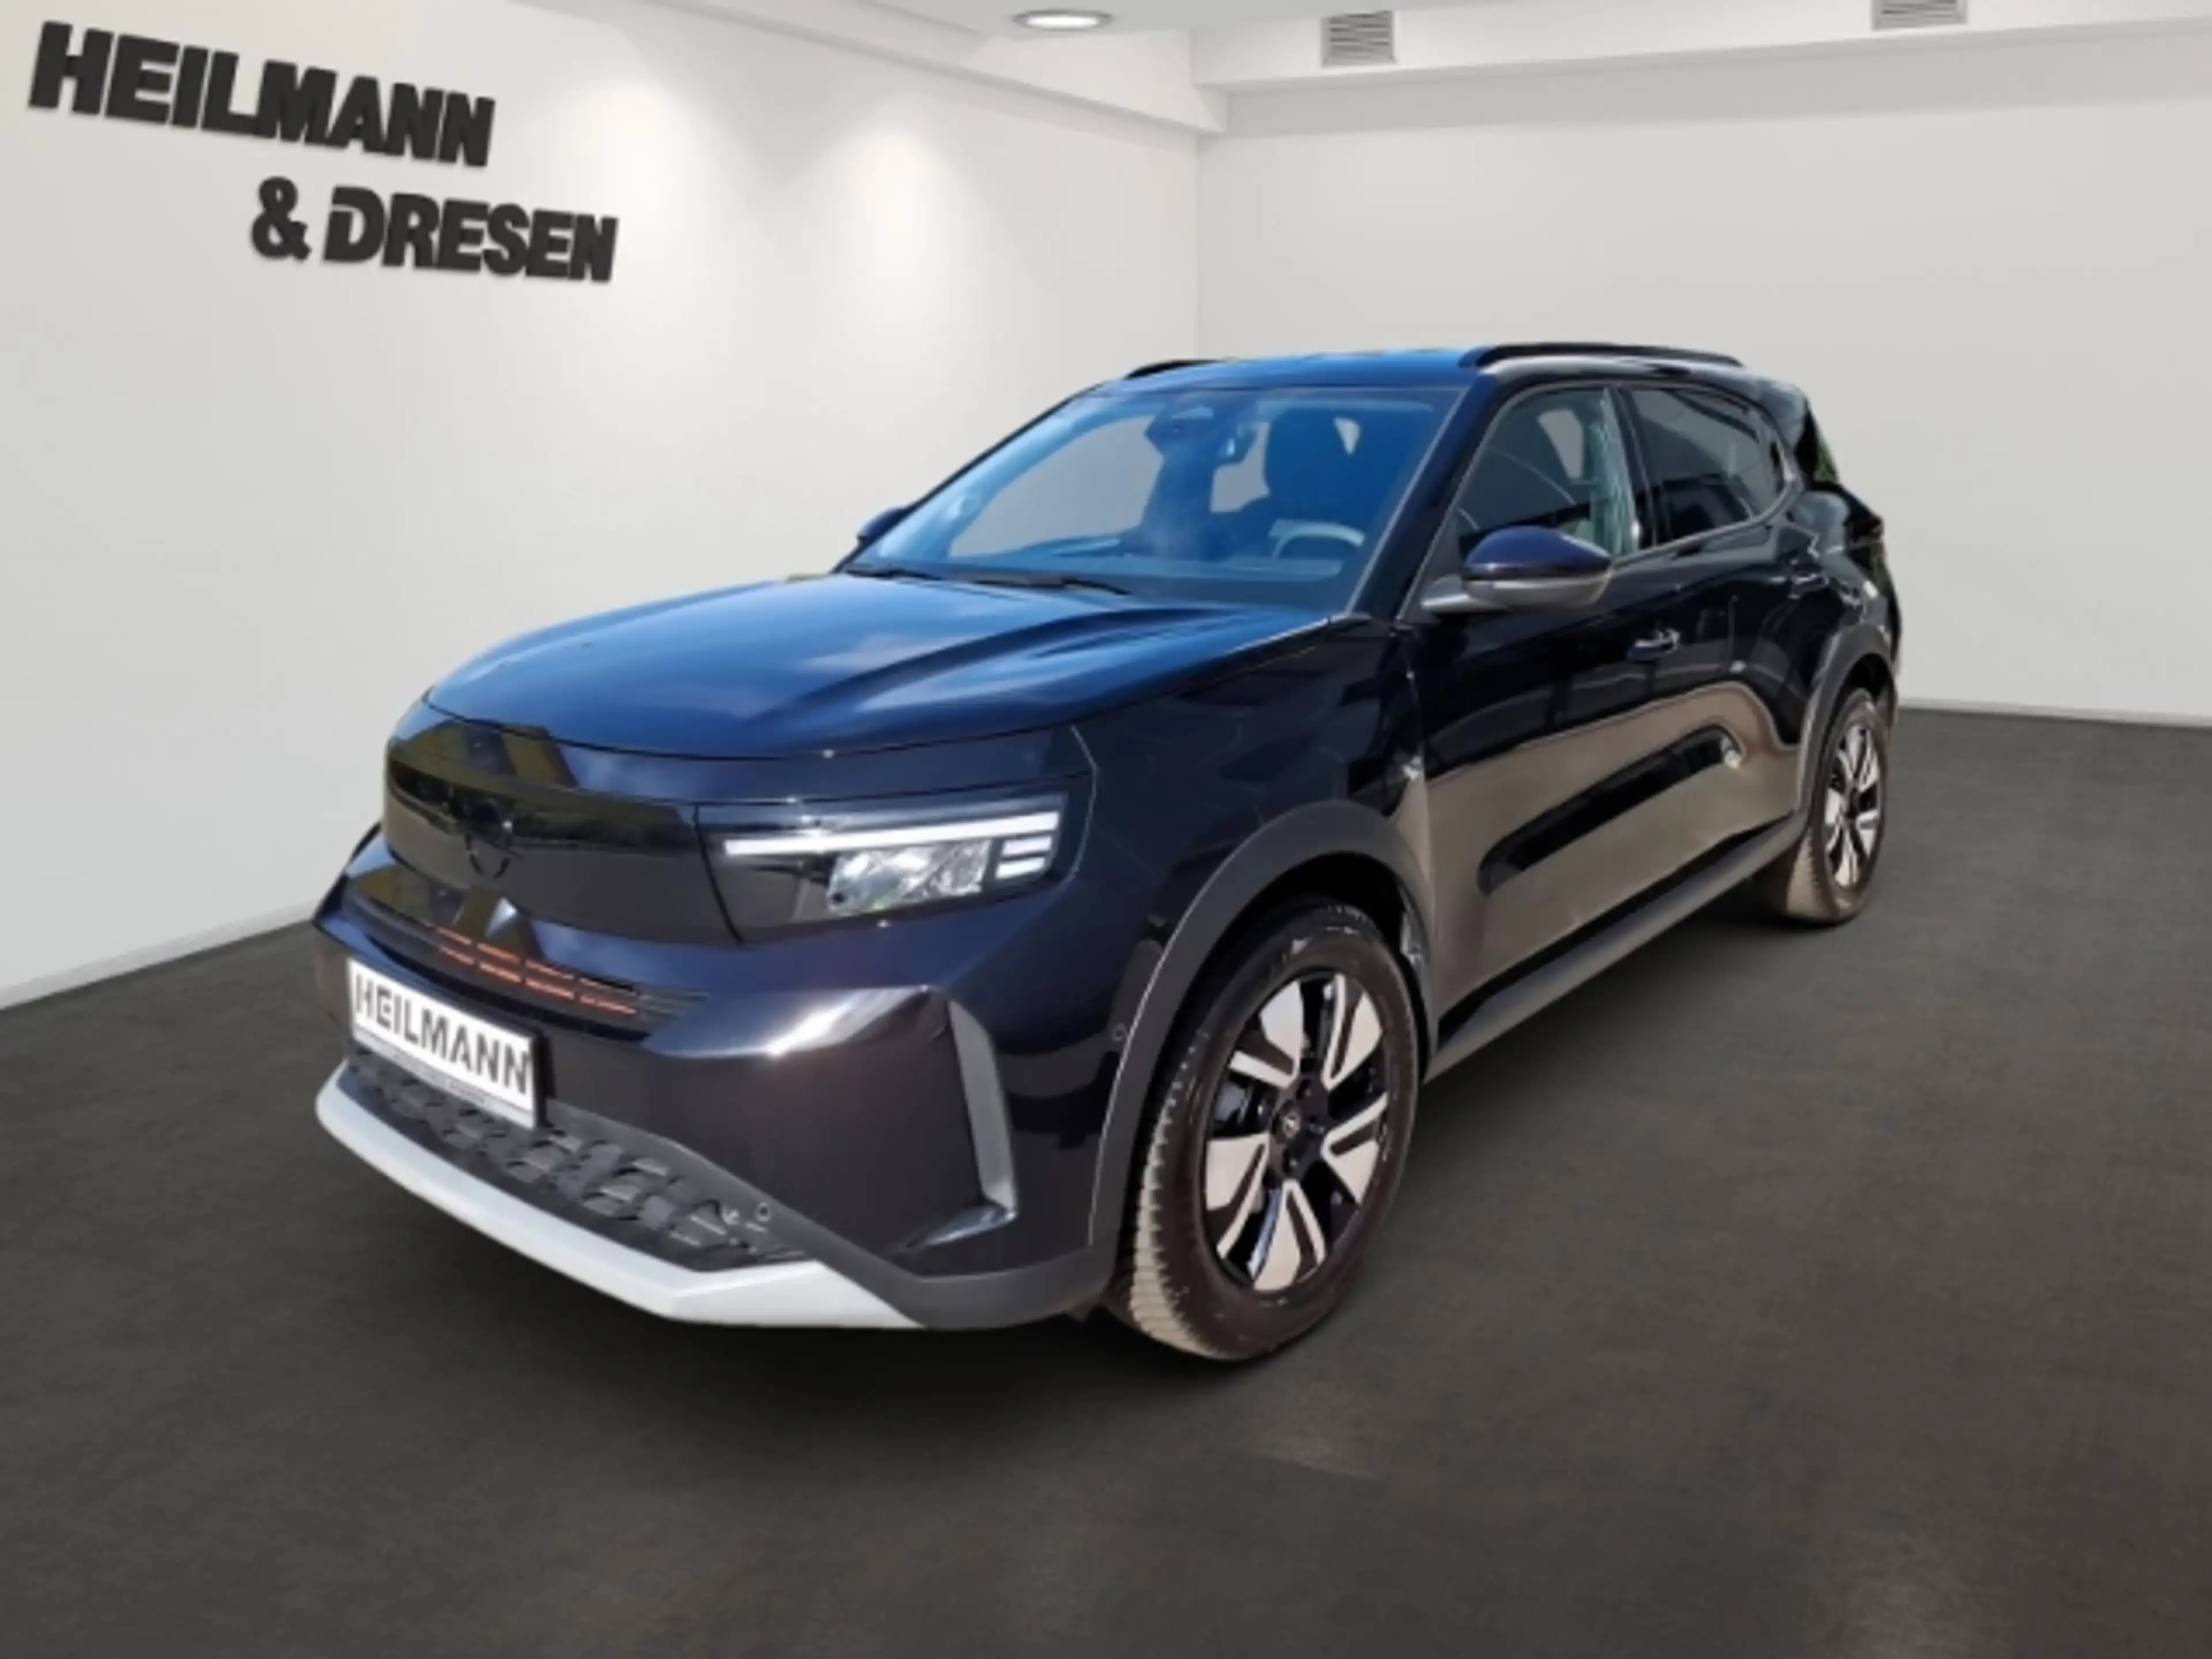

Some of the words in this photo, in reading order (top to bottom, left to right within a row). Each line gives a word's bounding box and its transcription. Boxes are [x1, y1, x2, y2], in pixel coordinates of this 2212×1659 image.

[28, 21, 495, 166] HEILMANN
[251, 176, 311, 260] &
[323, 186, 619, 282] DRESEN
[355, 972, 532, 1096] HEILMANN
